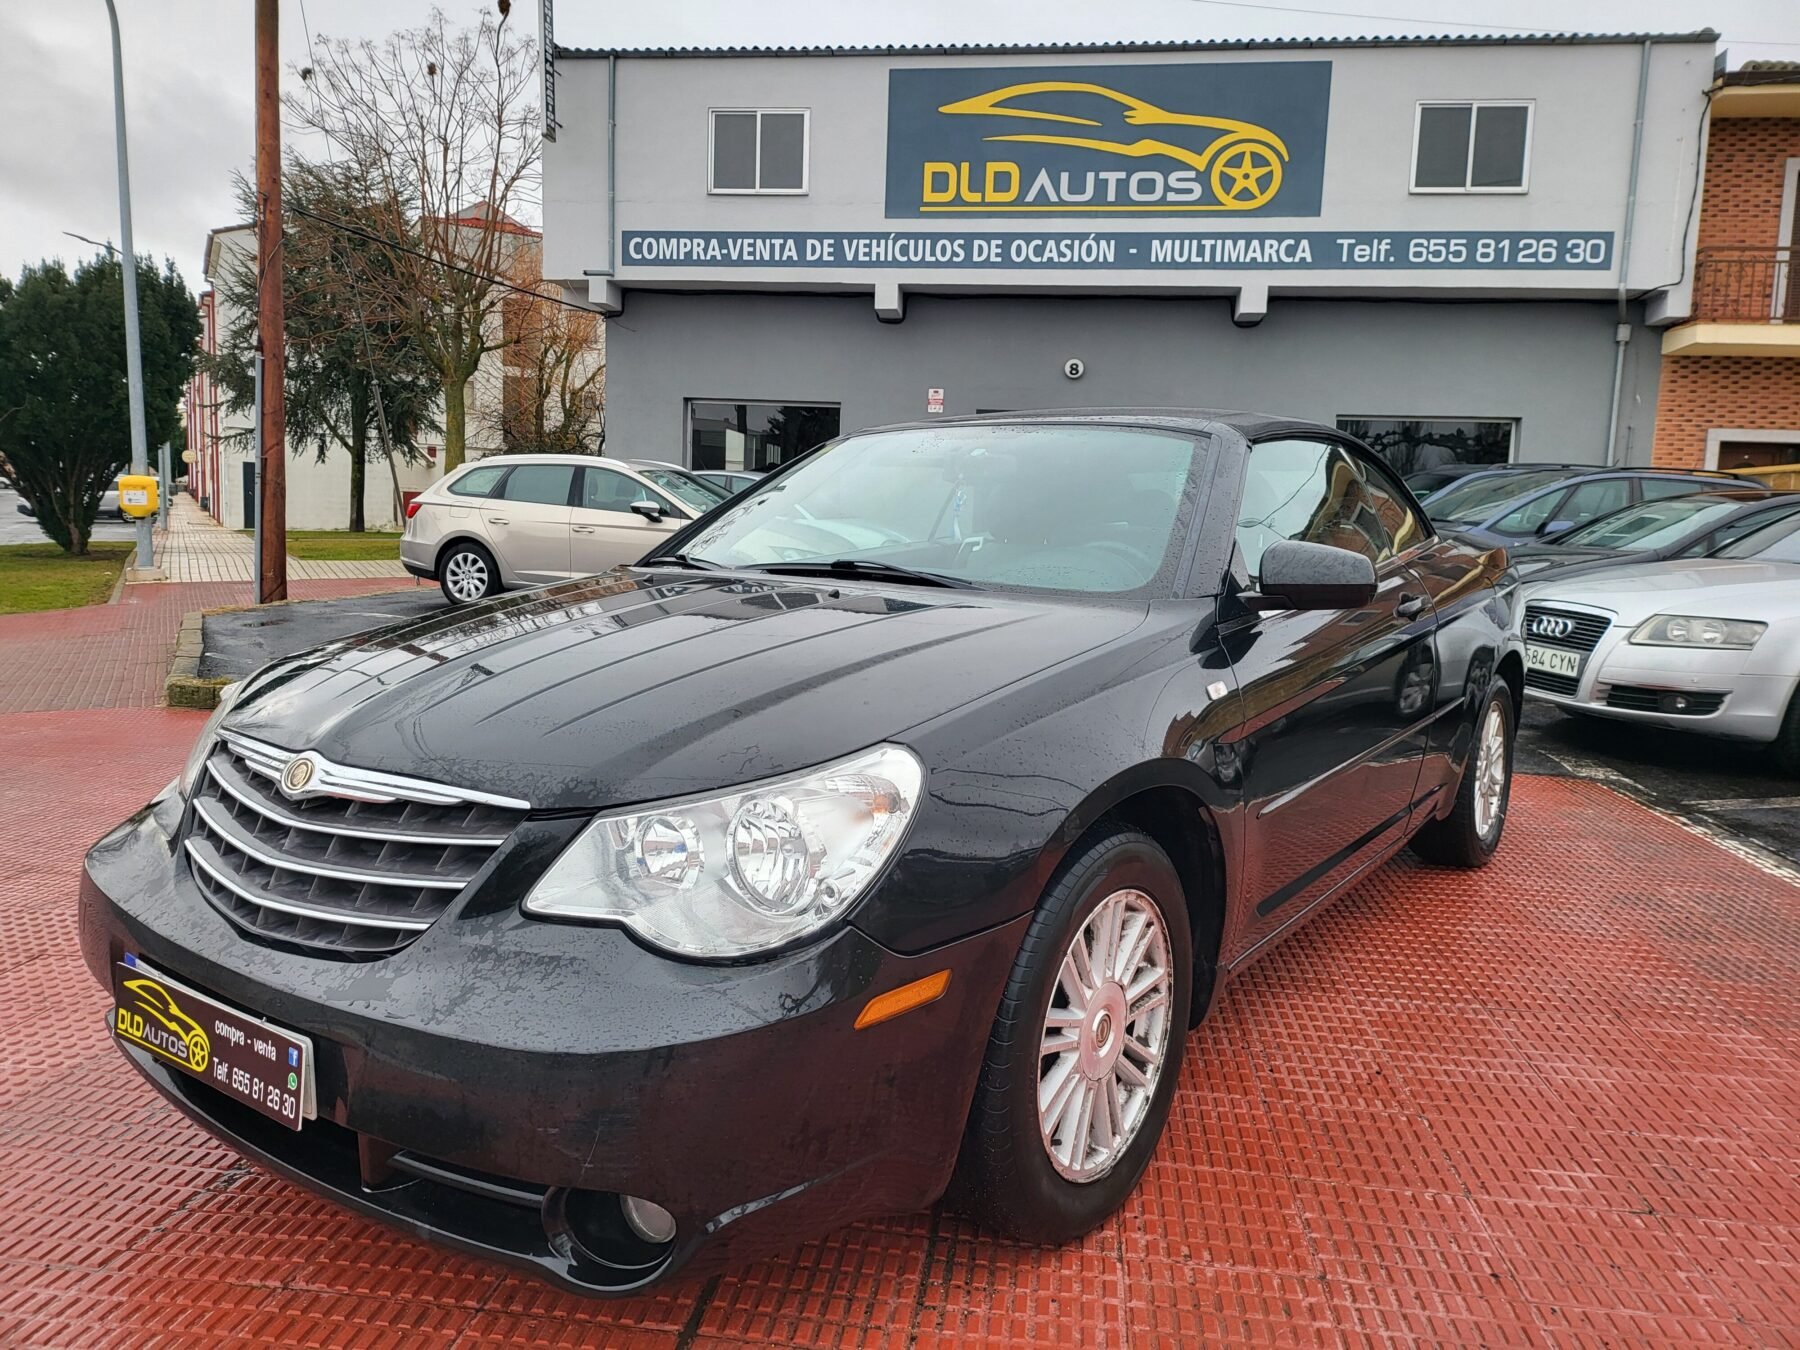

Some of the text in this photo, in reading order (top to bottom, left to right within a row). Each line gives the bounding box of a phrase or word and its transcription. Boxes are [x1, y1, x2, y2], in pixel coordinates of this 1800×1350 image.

[628, 237, 798, 261] COMPRA-VENTA
[806, 239, 835, 261] DE
[843, 233, 965, 262] VEHÍCULOS
[972, 239, 1002, 262] DE
[1010, 233, 1115, 263] OCASIÓN
[1150, 239, 1312, 263] MULTIMARCA
[1336, 238, 1395, 263] Telf.
[1408, 238, 1467, 263] 655
[1475, 238, 1509, 263] 81
[1516, 238, 1557, 263] 26
[1564, 238, 1606, 264] 30
[1069, 363, 1079, 375] 8
[1526, 648, 1576, 672] 584 CYN
[214, 1020, 245, 1046] compra
[253, 1038, 276, 1061] venta
[213, 1056, 295, 1119] Telf. 655 81 26 30
